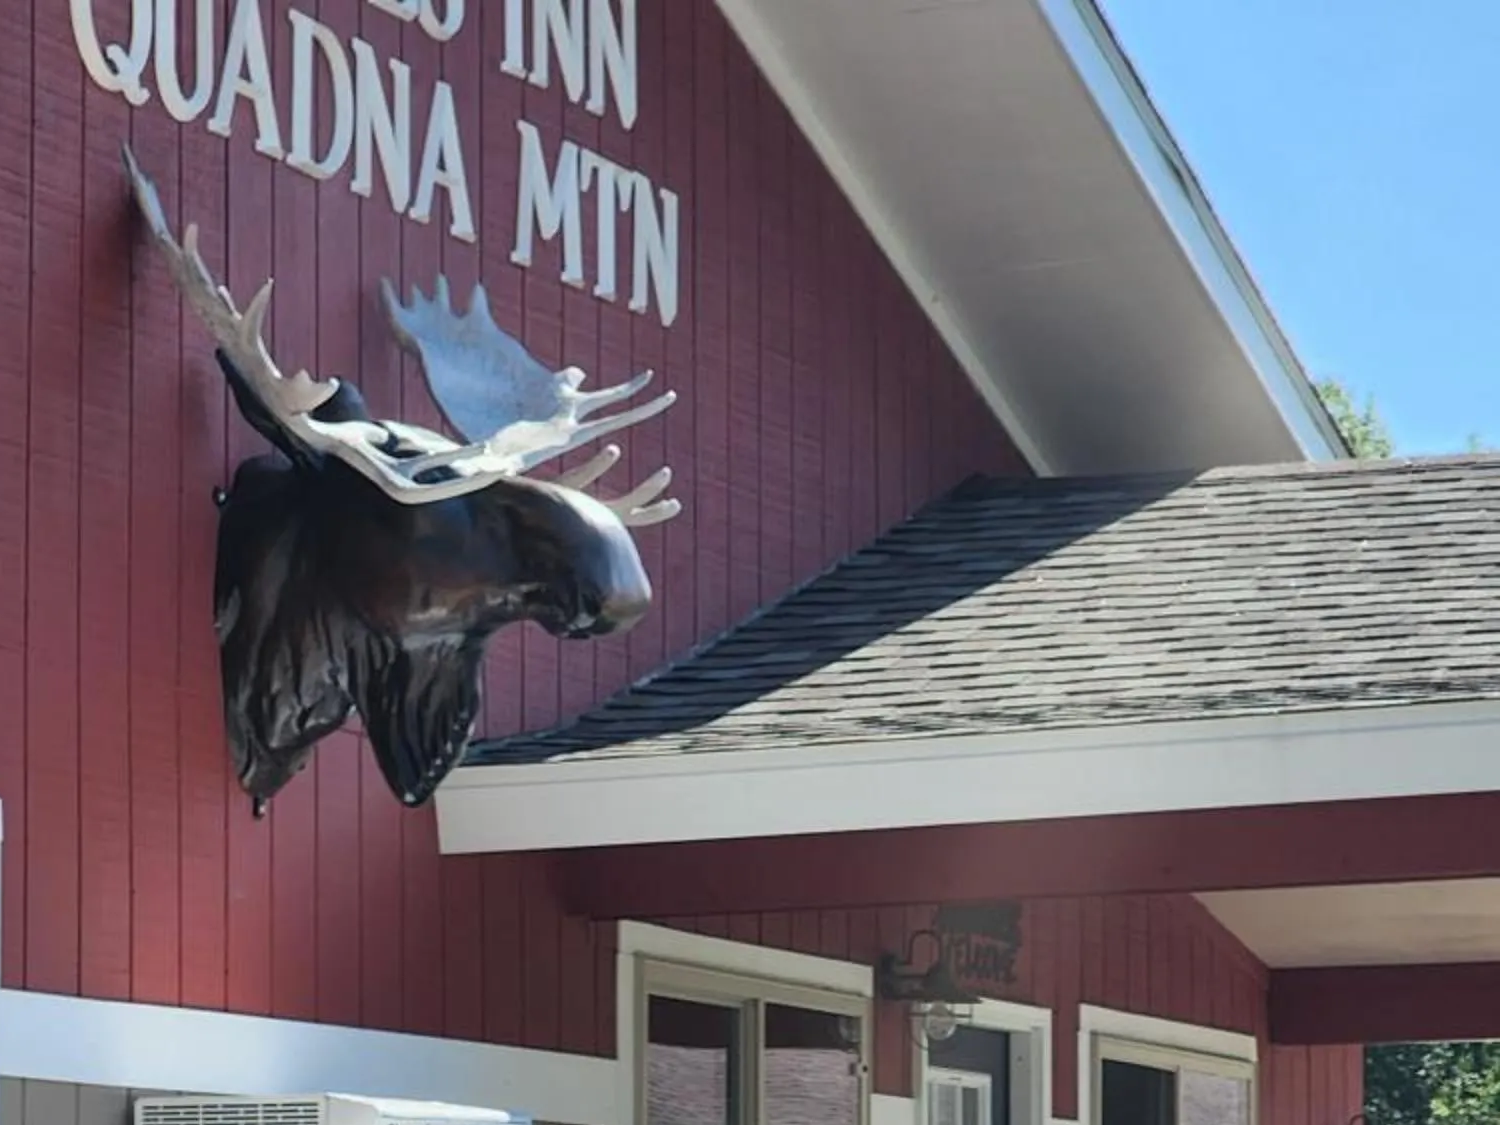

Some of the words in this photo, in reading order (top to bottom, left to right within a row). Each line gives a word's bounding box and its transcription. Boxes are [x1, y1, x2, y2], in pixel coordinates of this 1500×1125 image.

[71, 0, 475, 243] QUADNA
[509, 119, 679, 327] MTN
[501, 0, 637, 130] INN
